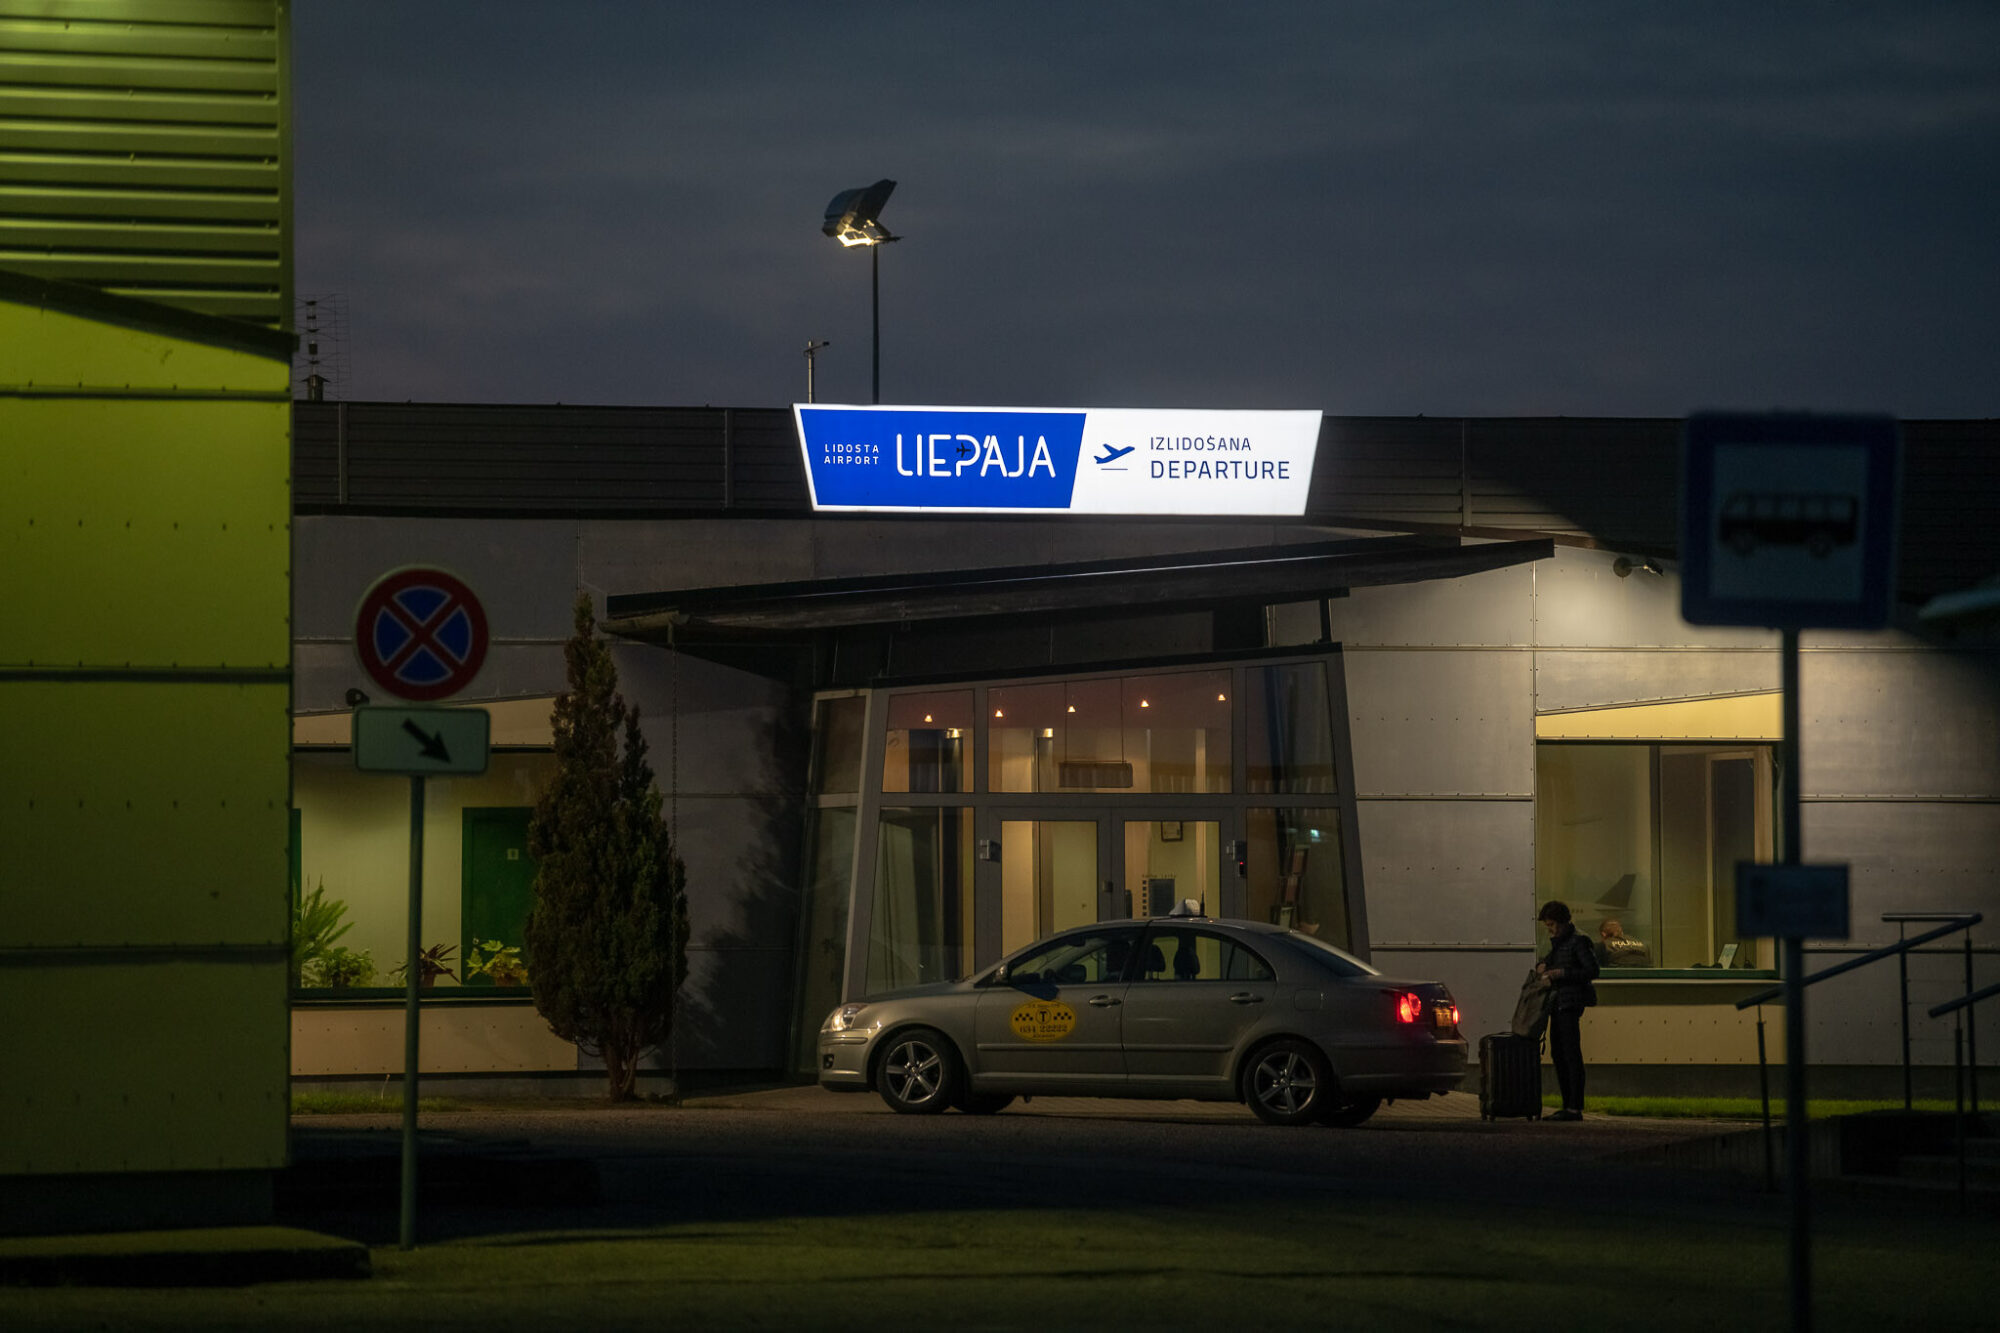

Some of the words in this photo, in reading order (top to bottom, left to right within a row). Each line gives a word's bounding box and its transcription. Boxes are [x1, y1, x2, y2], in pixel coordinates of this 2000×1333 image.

[824, 444, 880, 454] LIDOSTA
[1150, 435, 1252, 451] IZLIDOŠANA
[823, 455, 880, 465] AIRPORT
[1150, 460, 1290, 480] DEPARTURE
